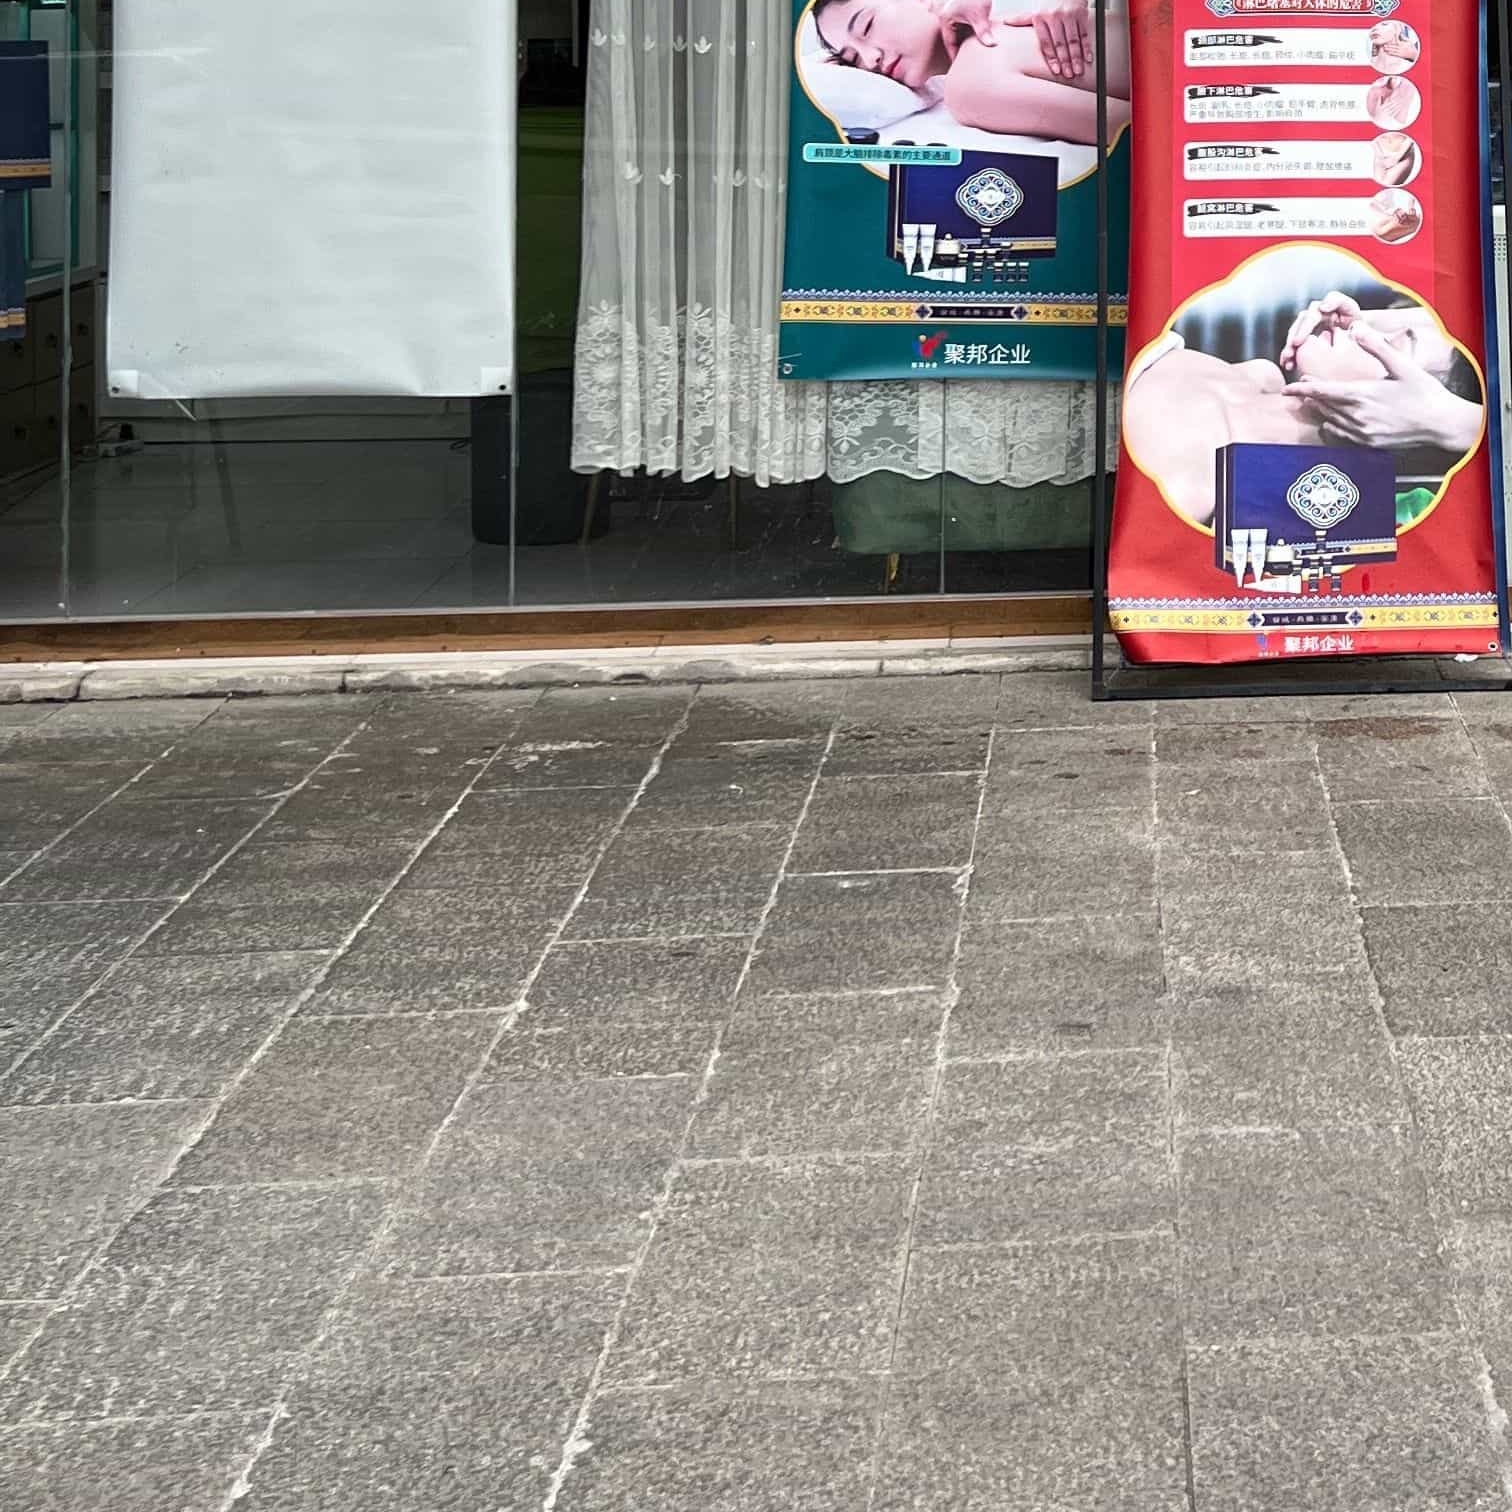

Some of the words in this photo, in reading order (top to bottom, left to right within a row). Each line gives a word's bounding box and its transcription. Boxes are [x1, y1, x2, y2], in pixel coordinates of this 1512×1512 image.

[943, 343, 1031, 365] 聚邦企业
[1284, 634, 1355, 654] 聚邦企业
